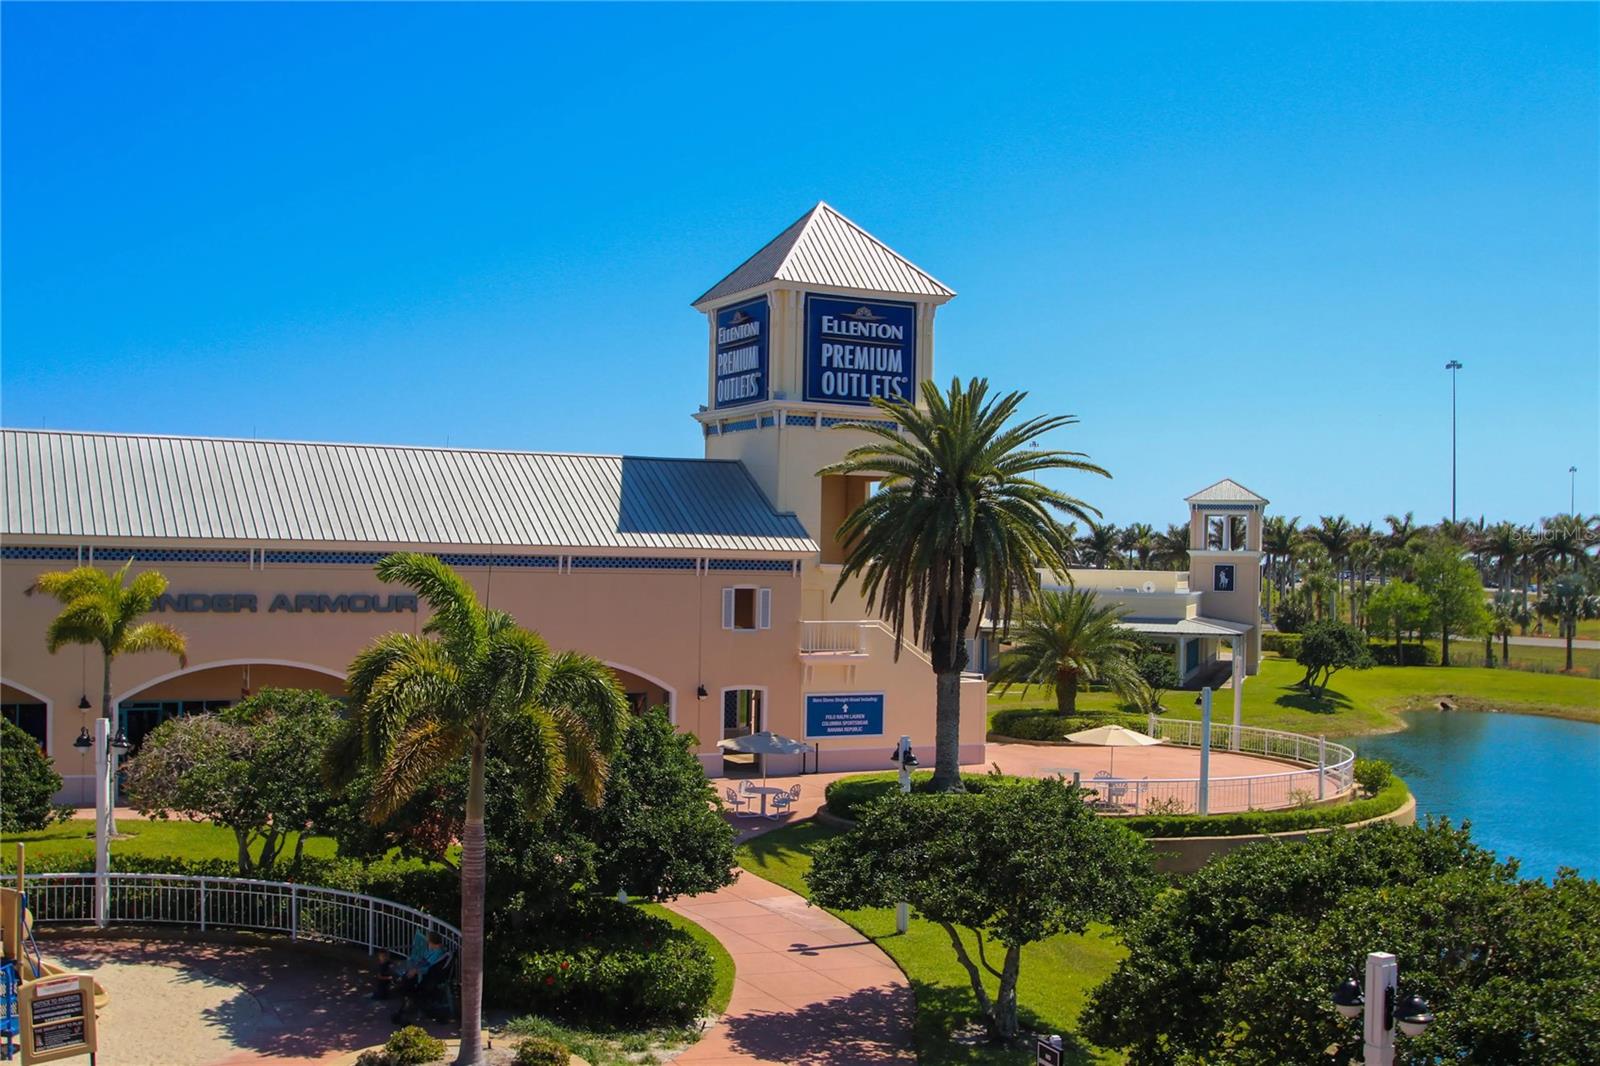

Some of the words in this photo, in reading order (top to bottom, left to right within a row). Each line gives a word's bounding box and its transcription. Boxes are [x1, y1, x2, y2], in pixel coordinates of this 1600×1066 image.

[718, 321, 760, 344] ELLENTON
[822, 315, 903, 340] ELLENTON
[718, 345, 759, 376] PREMIUM
[821, 343, 903, 373] PREMIUM
[268, 593, 418, 613] ARMOUR
